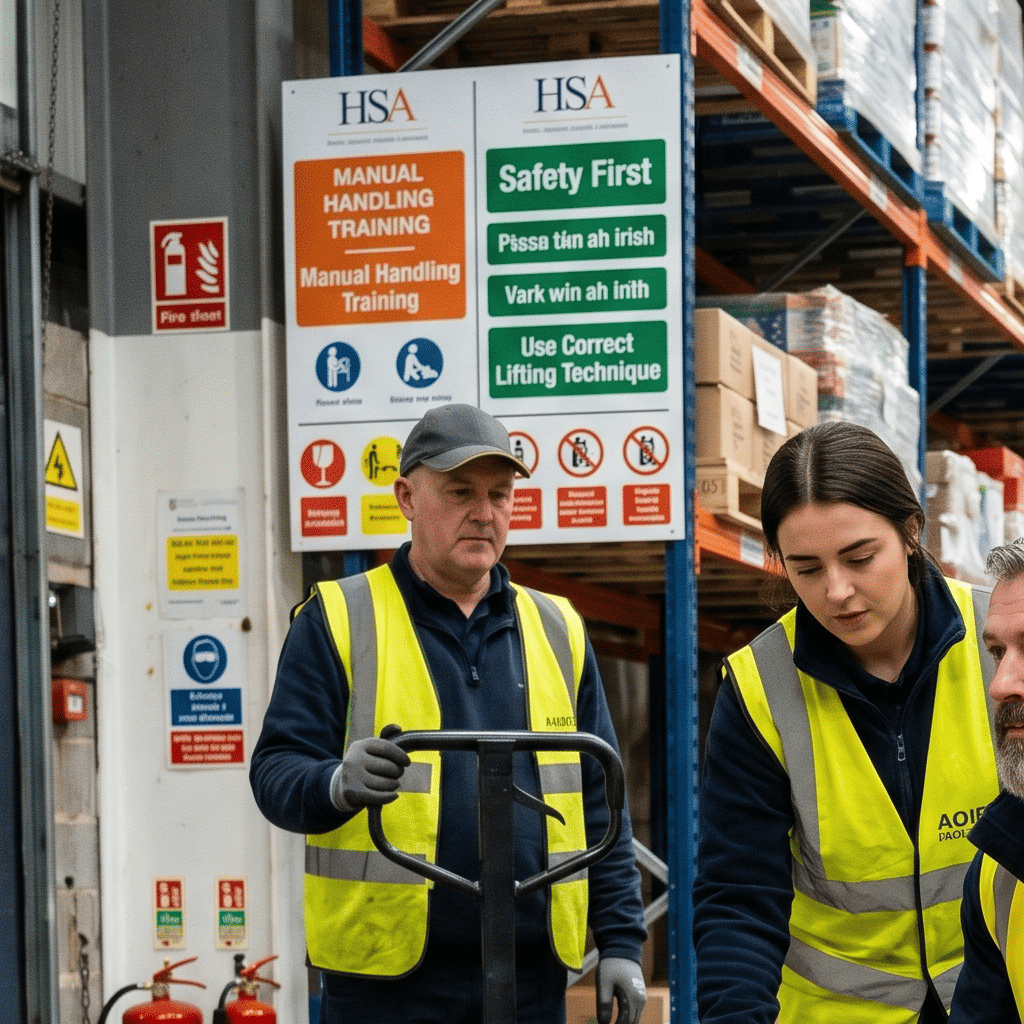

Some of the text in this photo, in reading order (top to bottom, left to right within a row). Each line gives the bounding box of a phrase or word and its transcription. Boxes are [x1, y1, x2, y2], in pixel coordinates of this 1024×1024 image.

[338, 87, 417, 126] HSA
[534, 74, 616, 113] HSA
[332, 163, 424, 188] MANUAL
[498, 156, 653, 196] Safety First
[323, 188, 434, 214] HANDLING
[327, 214, 431, 239] TRAINING
[587, 228, 610, 249] ah
[614, 226, 655, 248] irish
[300, 258, 461, 289] Manual Handling
[342, 289, 419, 315] Training
[504, 284, 546, 305] Vark
[548, 282, 582, 303] win
[585, 281, 609, 301] ah
[520, 331, 634, 358] Use Correct
[495, 357, 662, 389] Lifting Technique
